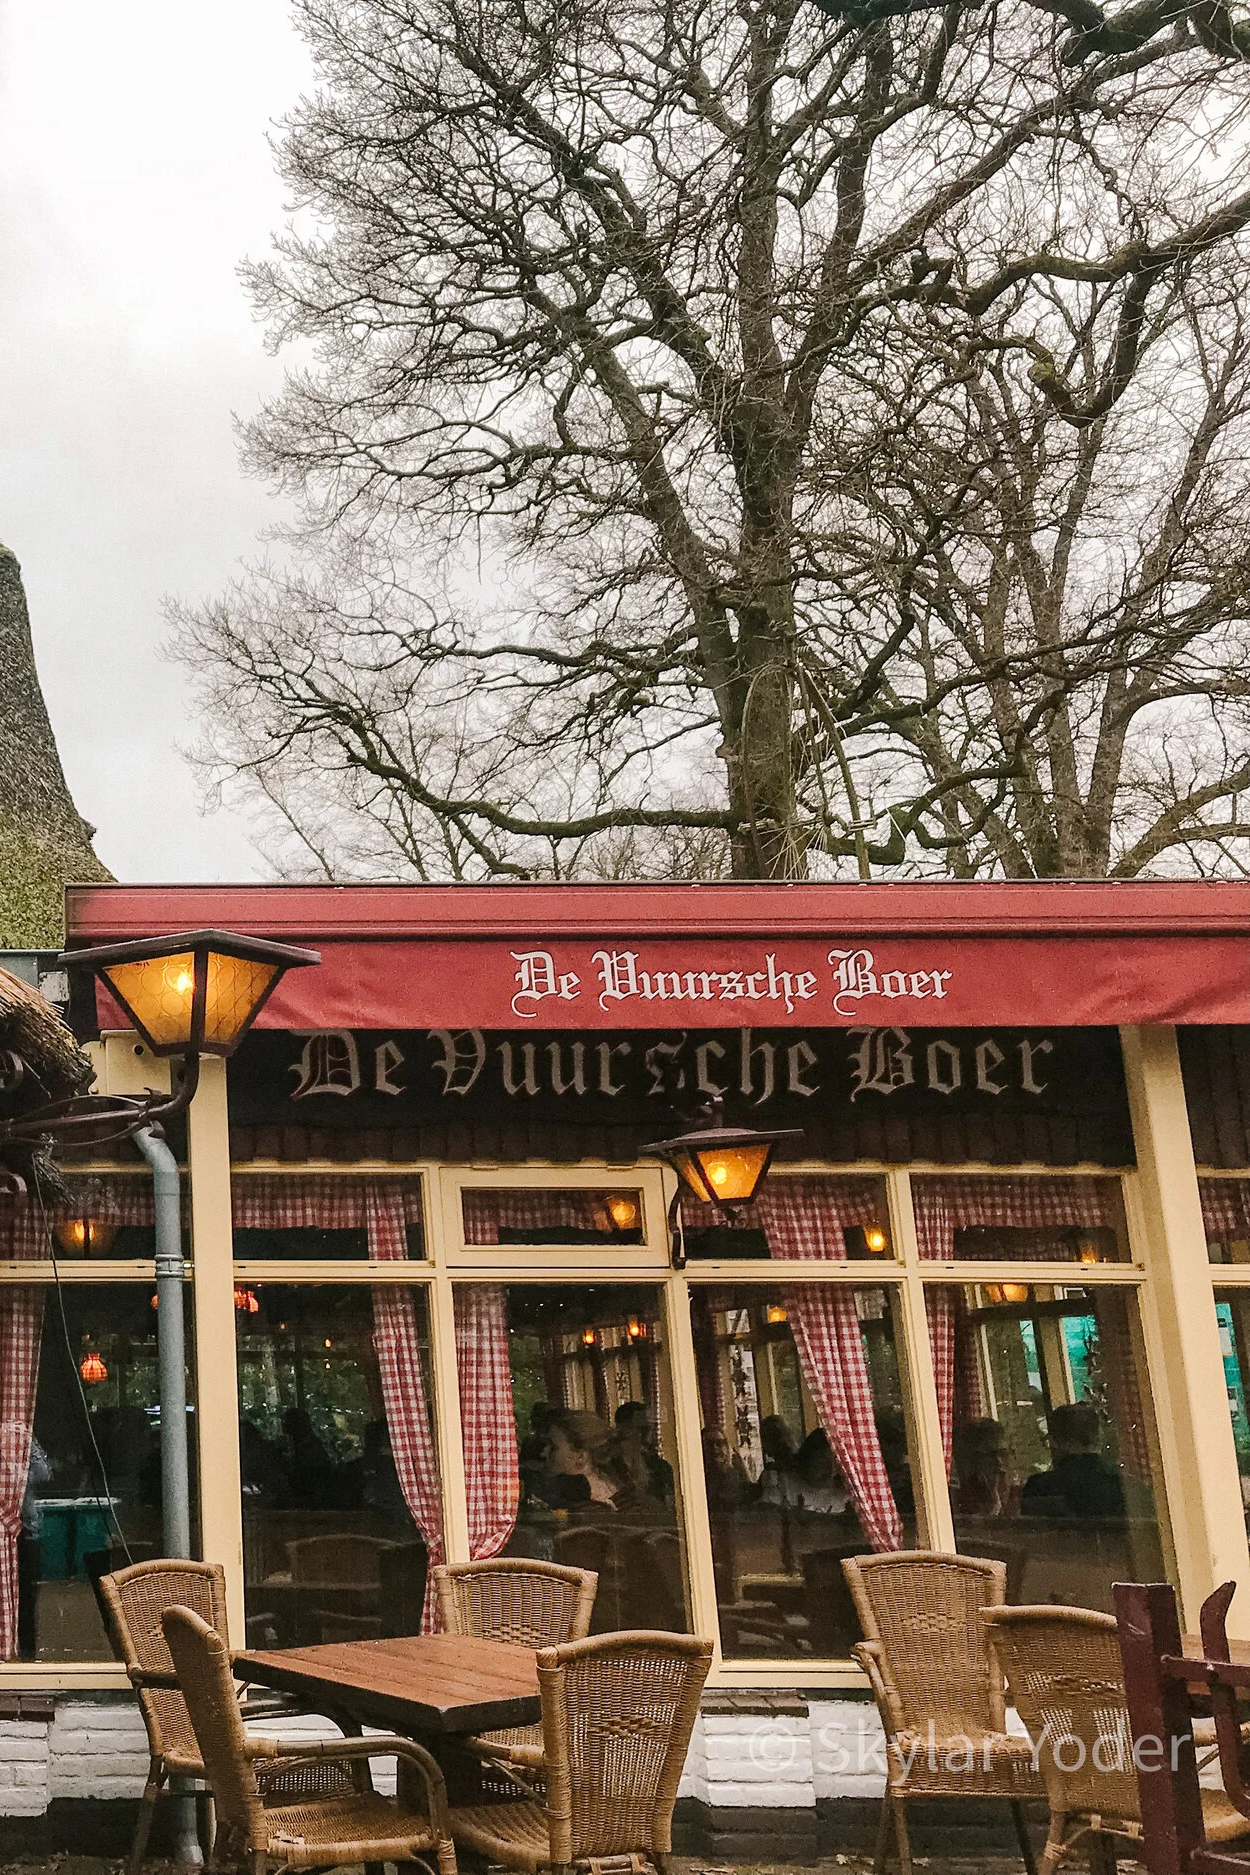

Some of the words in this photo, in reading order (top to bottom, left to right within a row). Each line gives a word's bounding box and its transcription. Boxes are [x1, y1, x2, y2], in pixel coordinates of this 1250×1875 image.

[509, 949, 582, 1018] De
[590, 950, 819, 1014] Vuursche
[826, 949, 954, 1017] Boer
[287, 1028, 407, 1100] De
[426, 1028, 820, 1105] Vuursche
[847, 1027, 1053, 1102] Boer
